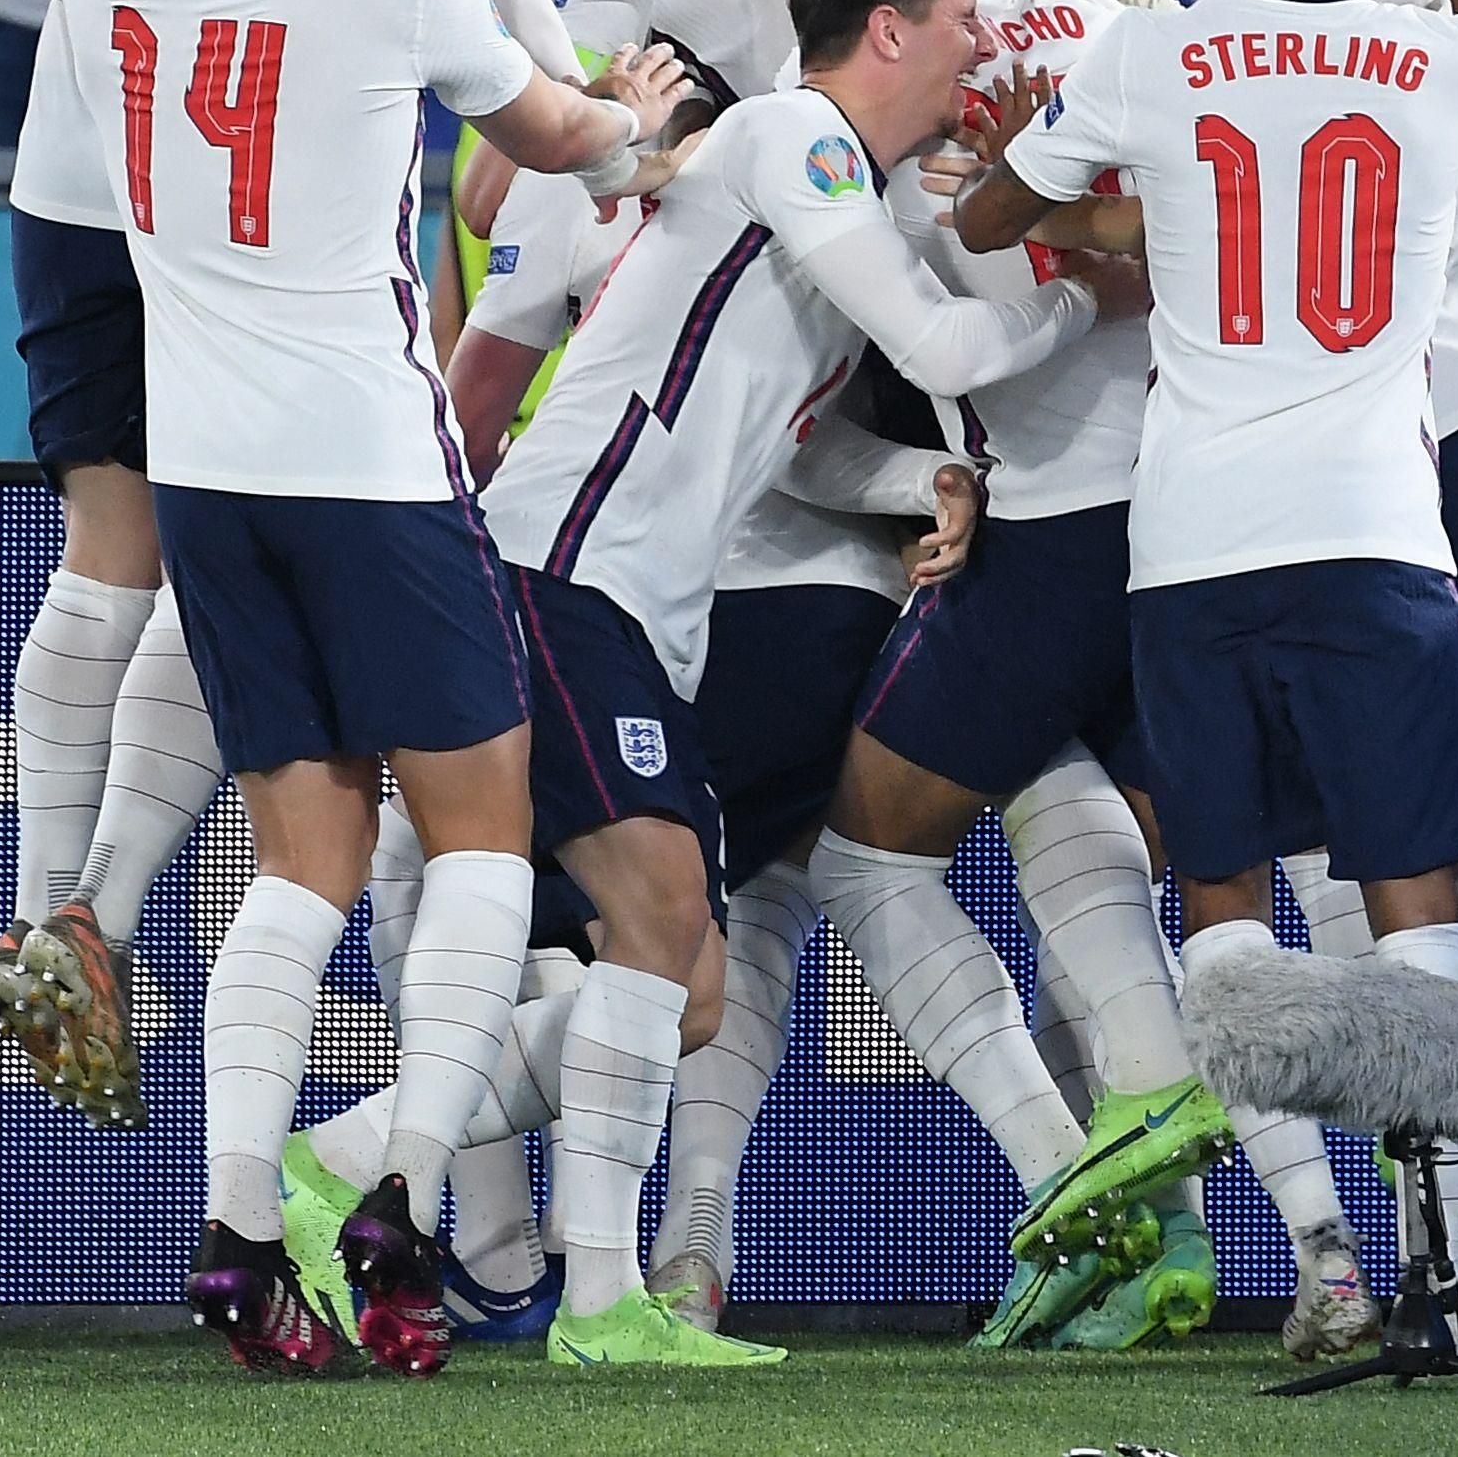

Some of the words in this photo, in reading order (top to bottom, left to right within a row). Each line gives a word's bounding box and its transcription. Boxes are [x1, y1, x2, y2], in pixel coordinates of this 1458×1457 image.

[111, 4, 288, 248] 14
[1181, 32, 1429, 92] STERLING
[1194, 112, 1401, 354] 10
